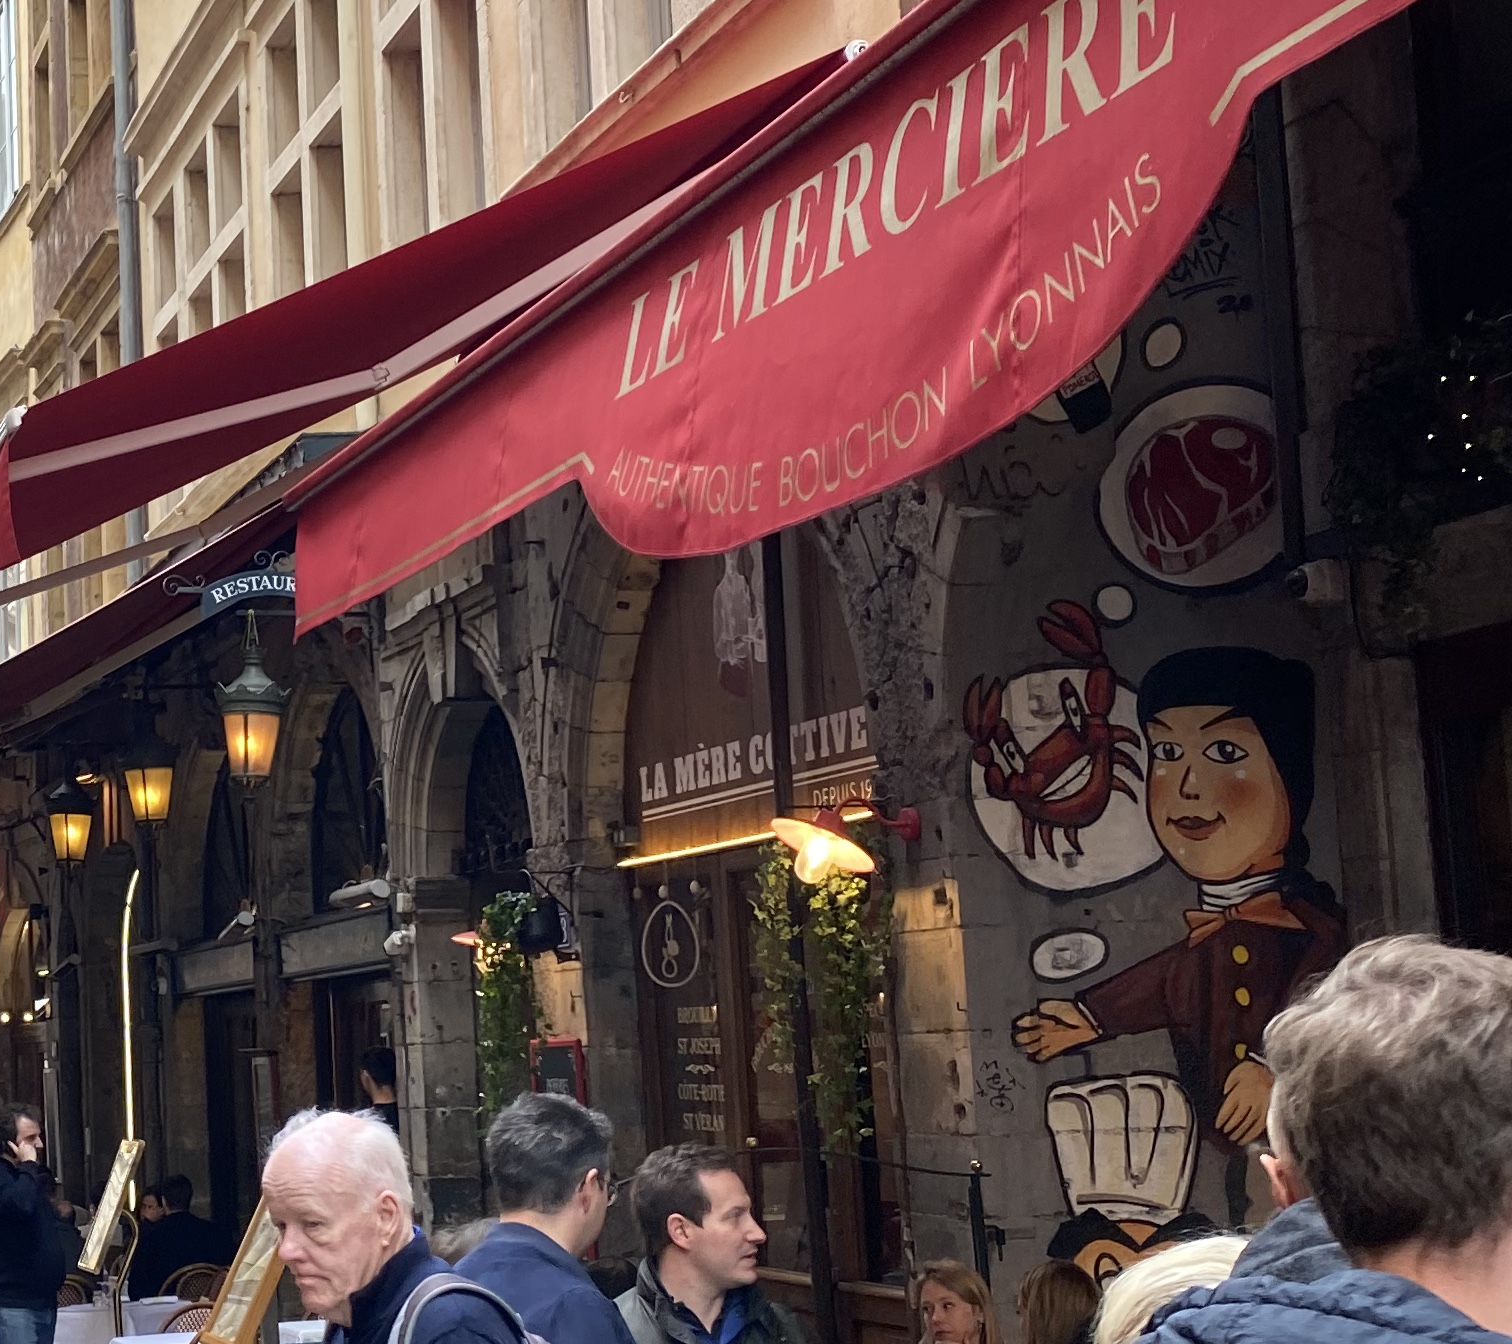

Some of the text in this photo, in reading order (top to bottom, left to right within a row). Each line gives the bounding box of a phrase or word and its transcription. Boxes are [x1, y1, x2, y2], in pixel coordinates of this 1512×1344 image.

[605, 446, 763, 516] AUTHENTIQUE
[778, 367, 947, 508] BOUCHON
[969, 150, 1161, 391] LYONNAIS
[615, 266, 699, 400] LE
[210, 575, 296, 604] RESTAUR
[639, 762, 669, 803] LA
[673, 742, 742, 795] MÈRE
[859, 777, 873, 800] 19
